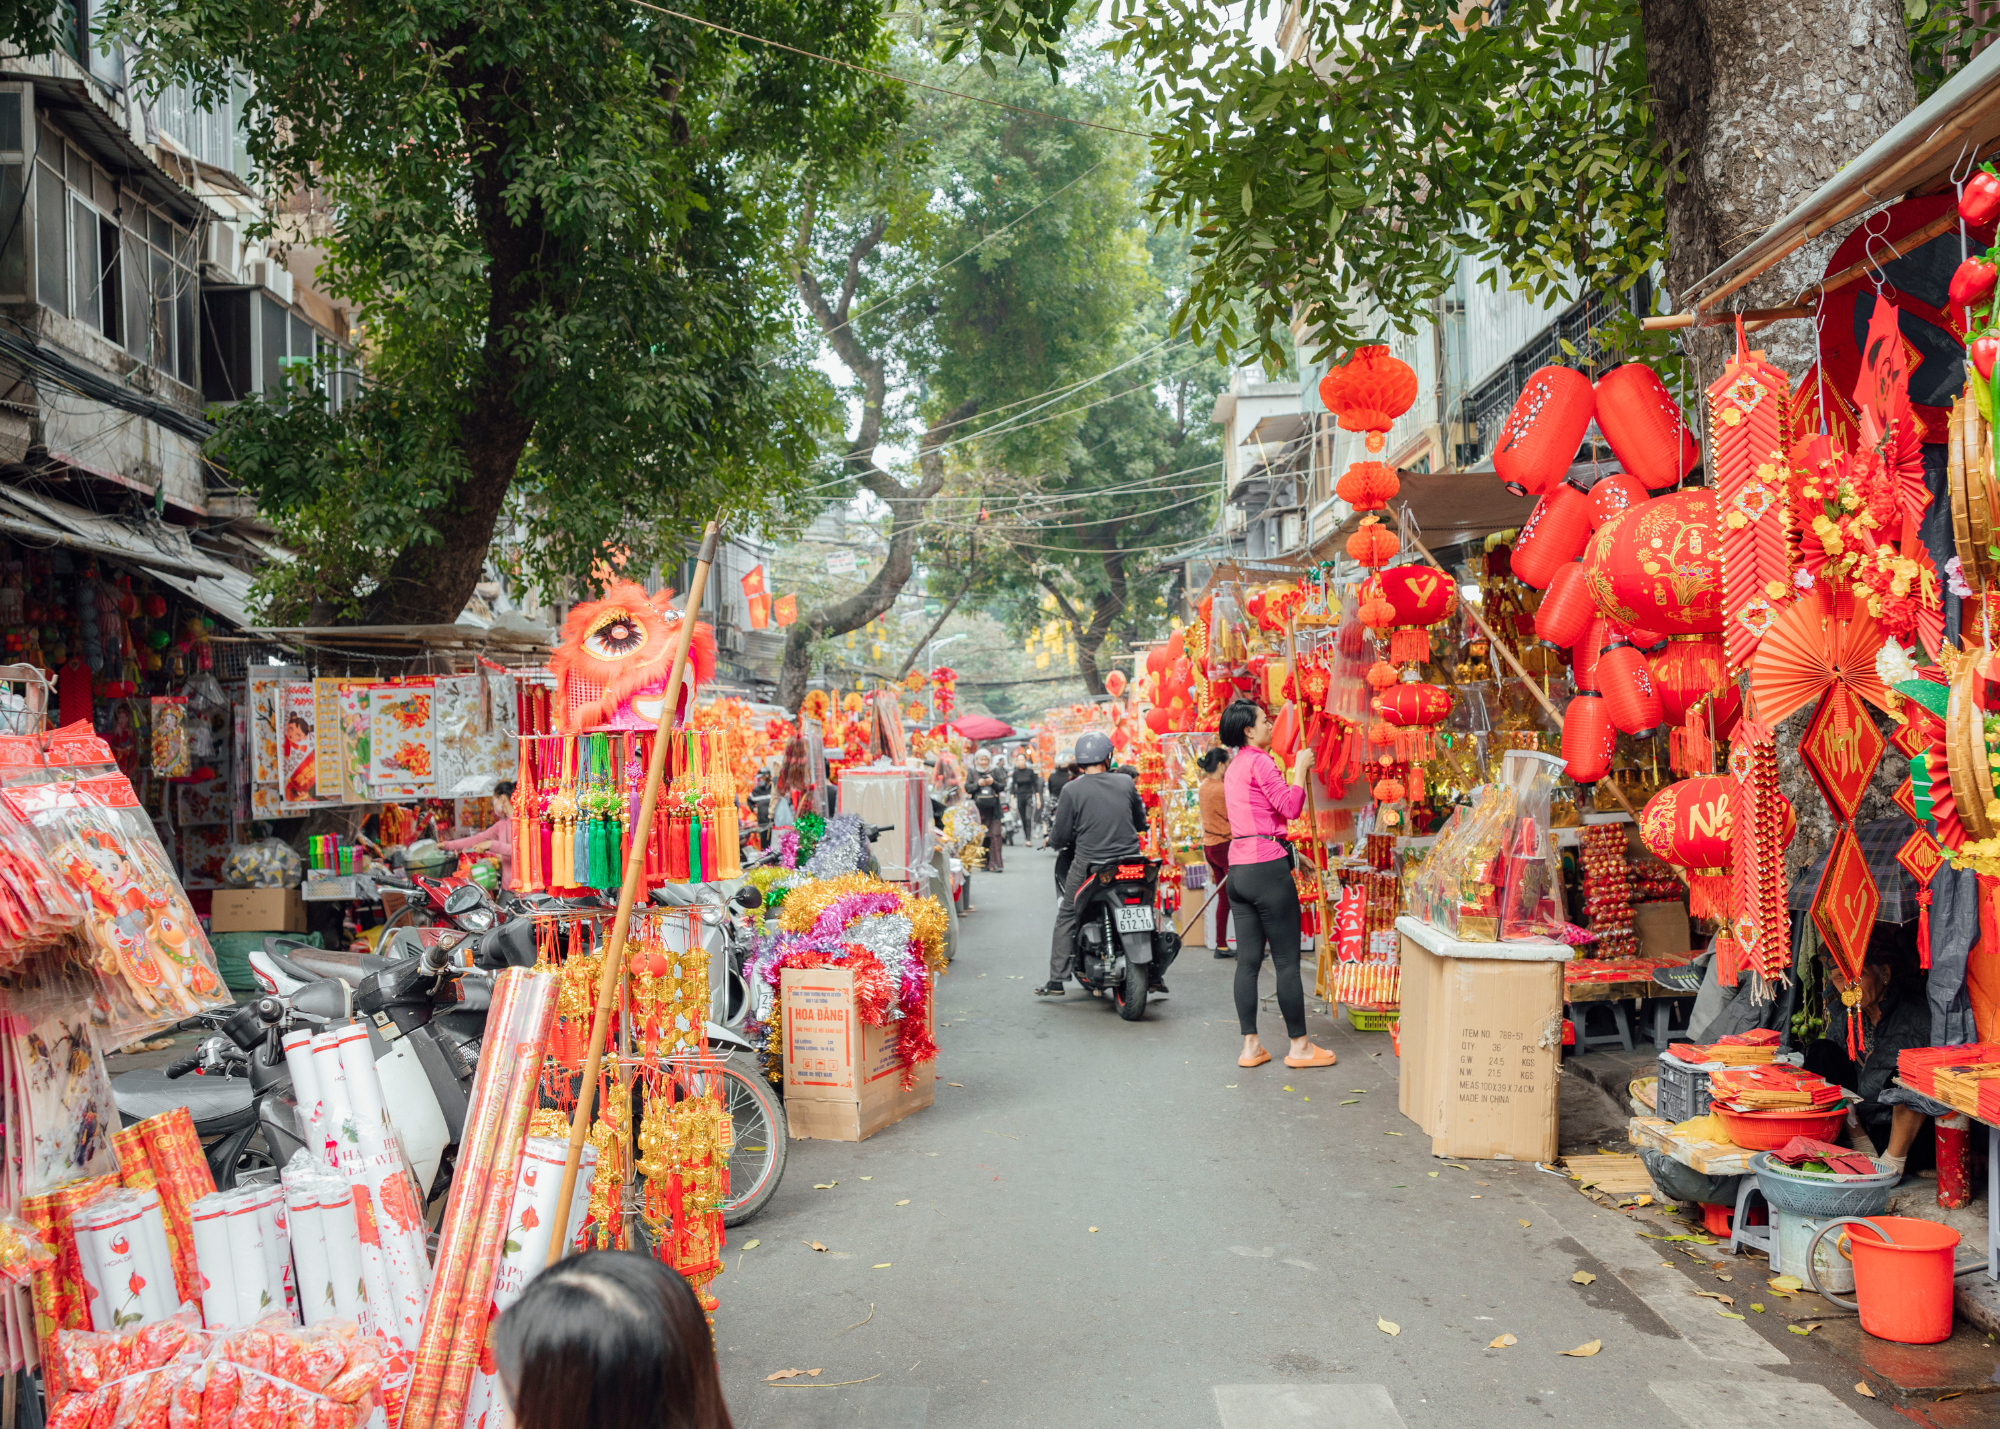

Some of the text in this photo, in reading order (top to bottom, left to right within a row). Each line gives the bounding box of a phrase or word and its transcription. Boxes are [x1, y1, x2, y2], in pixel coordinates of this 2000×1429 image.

[1121, 908, 1147, 919] 29-C1
[1120, 919, 1151, 930] 612.10
[795, 1007, 843, 1021] HOA ĐĂNG
[1462, 1028, 1478, 1037] ITEM
[1481, 1030, 1491, 1038] NO.
[1461, 1042, 1535, 1053] QTY: 36 PCS
[1489, 1057, 1504, 1066] 24.5
[1522, 1059, 1535, 1067] KGS
[1488, 1069, 1501, 1077] 21.5
[1520, 1071, 1534, 1079] KGS
[1459, 1094, 1478, 1102] MADE
[1490, 1095, 1510, 1103] CHINA
